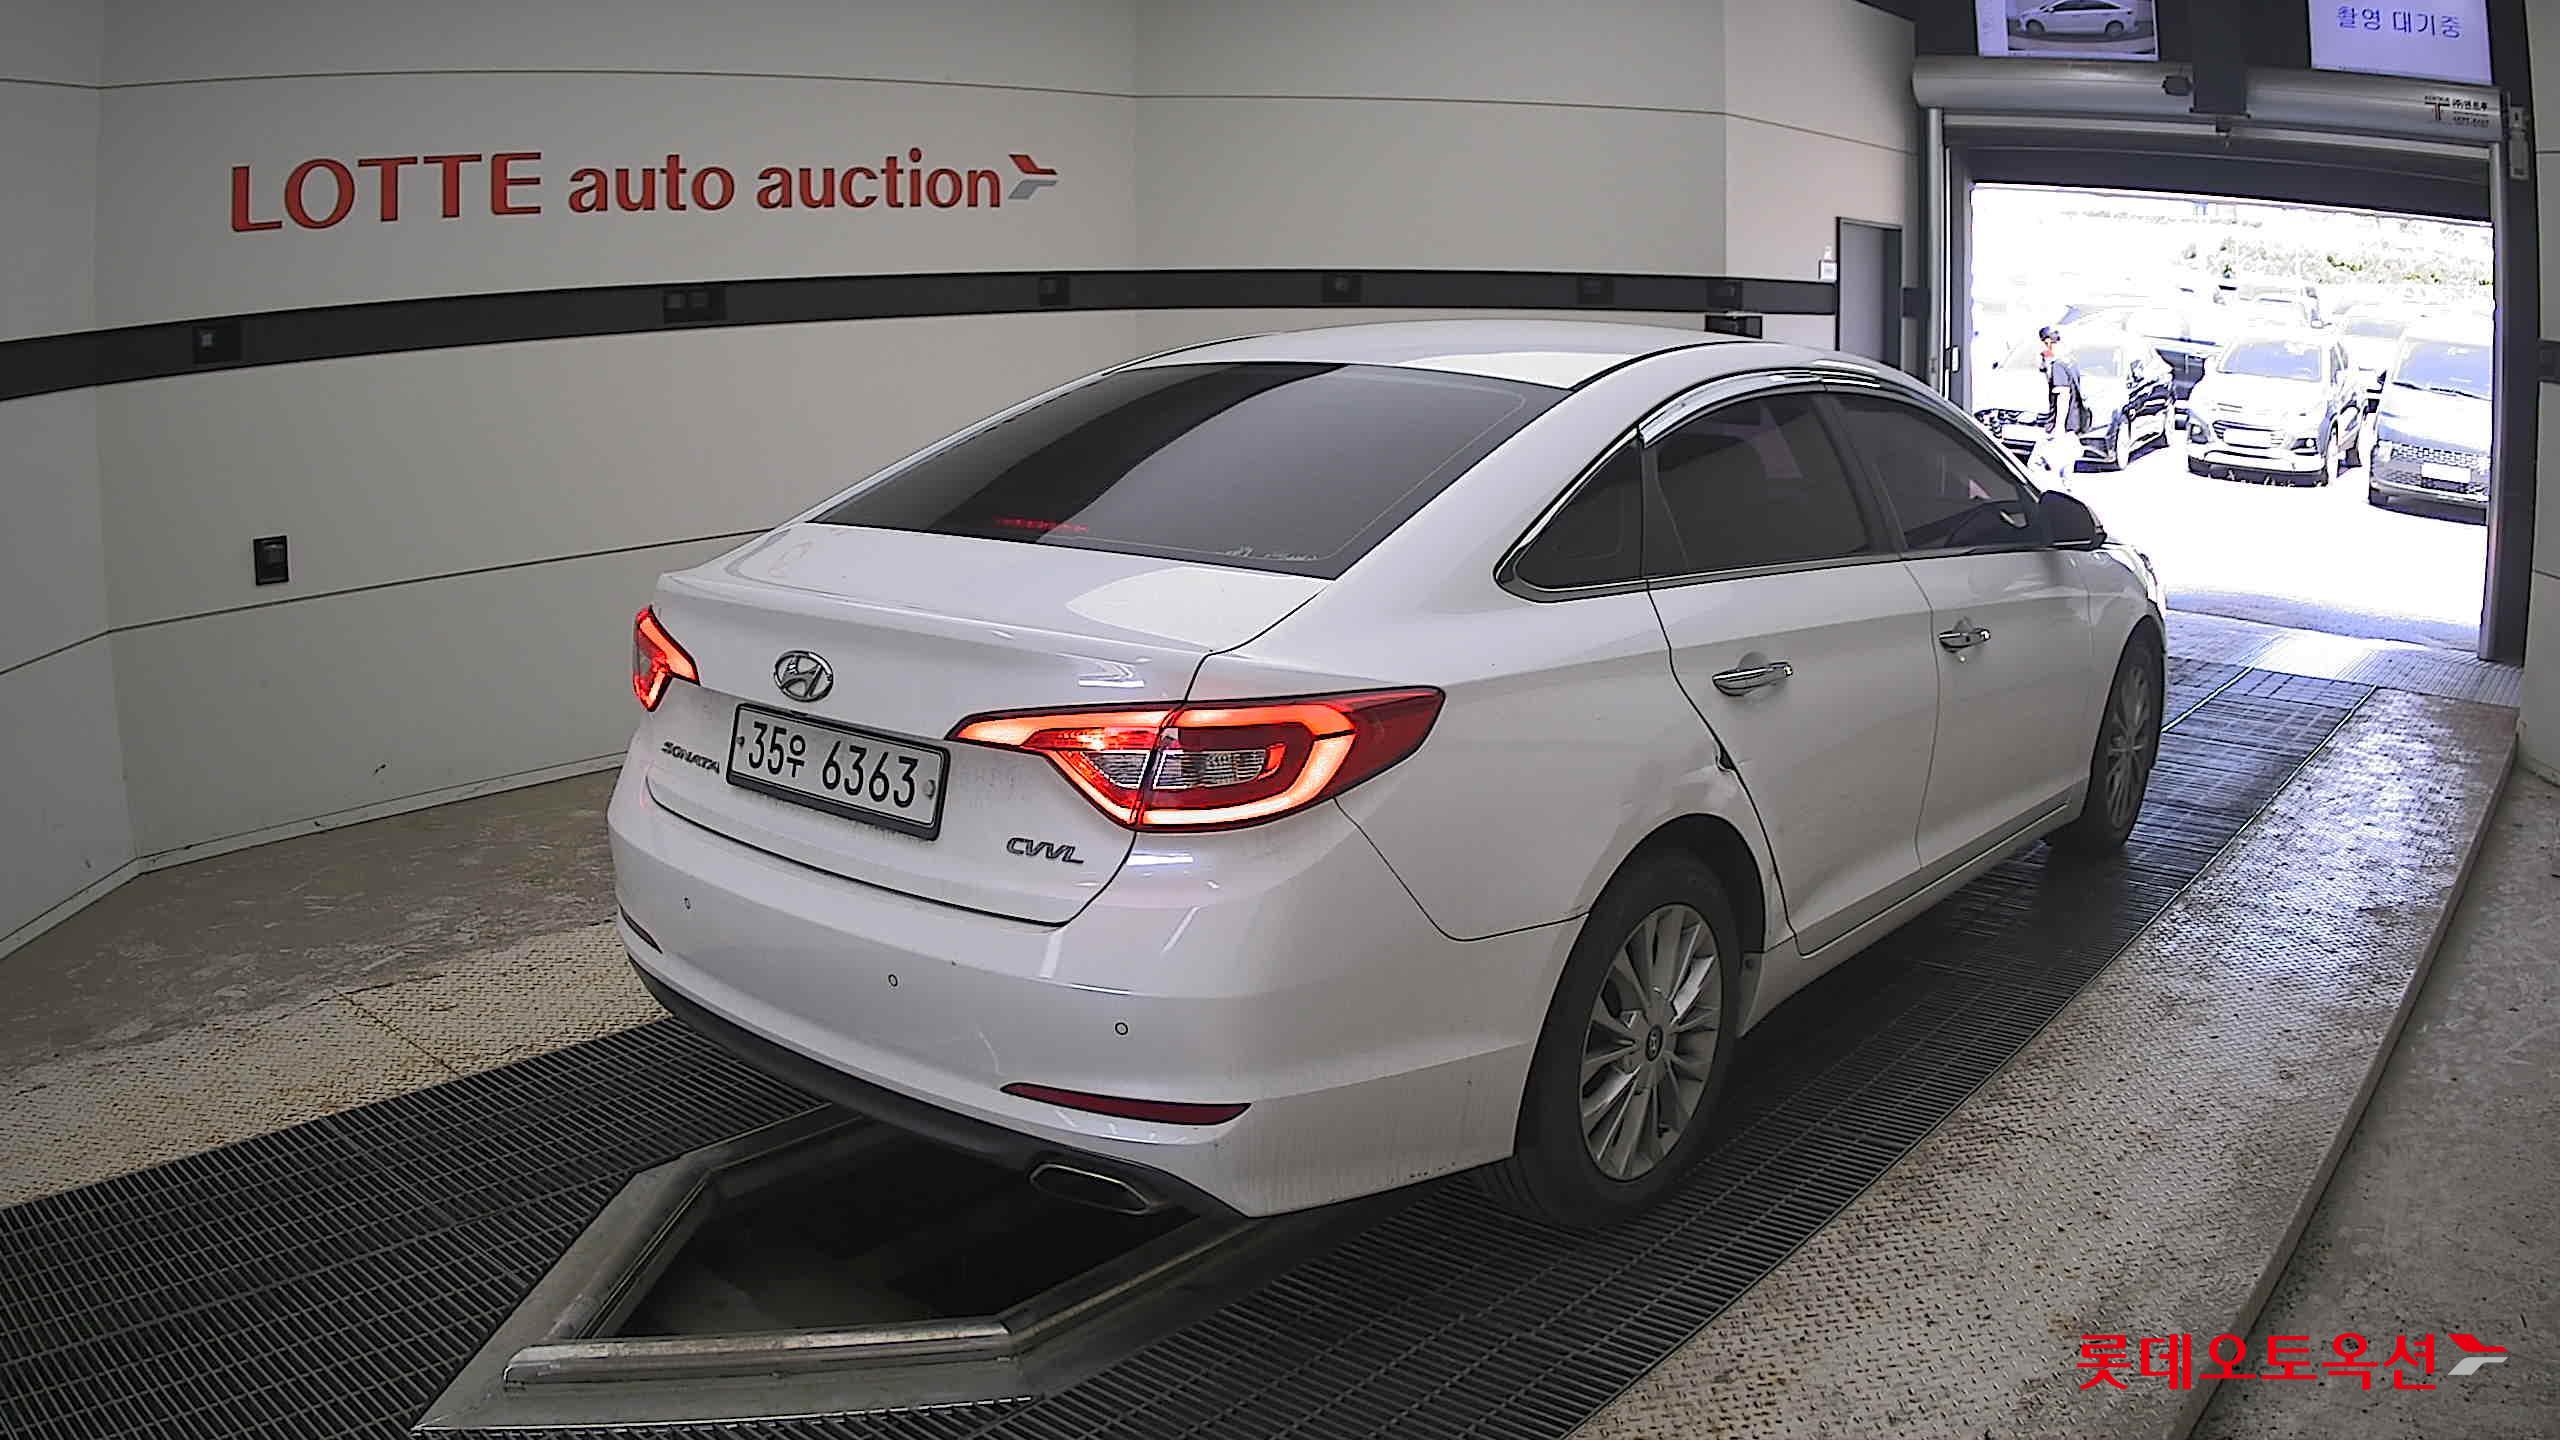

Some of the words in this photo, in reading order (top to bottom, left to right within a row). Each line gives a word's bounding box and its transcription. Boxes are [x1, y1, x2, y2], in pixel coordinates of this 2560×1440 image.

[2336, 6, 2381, 31] 촬영
[2392, 10, 2463, 39] 대기중
[231, 152, 541, 232] LOTTE
[568, 154, 735, 213] auto
[756, 149, 1003, 209] auction
[661, 741, 721, 774] SONATA
[748, 721, 807, 778] 35우
[822, 740, 919, 808] 6363
[1006, 837, 1085, 865] CVVL
